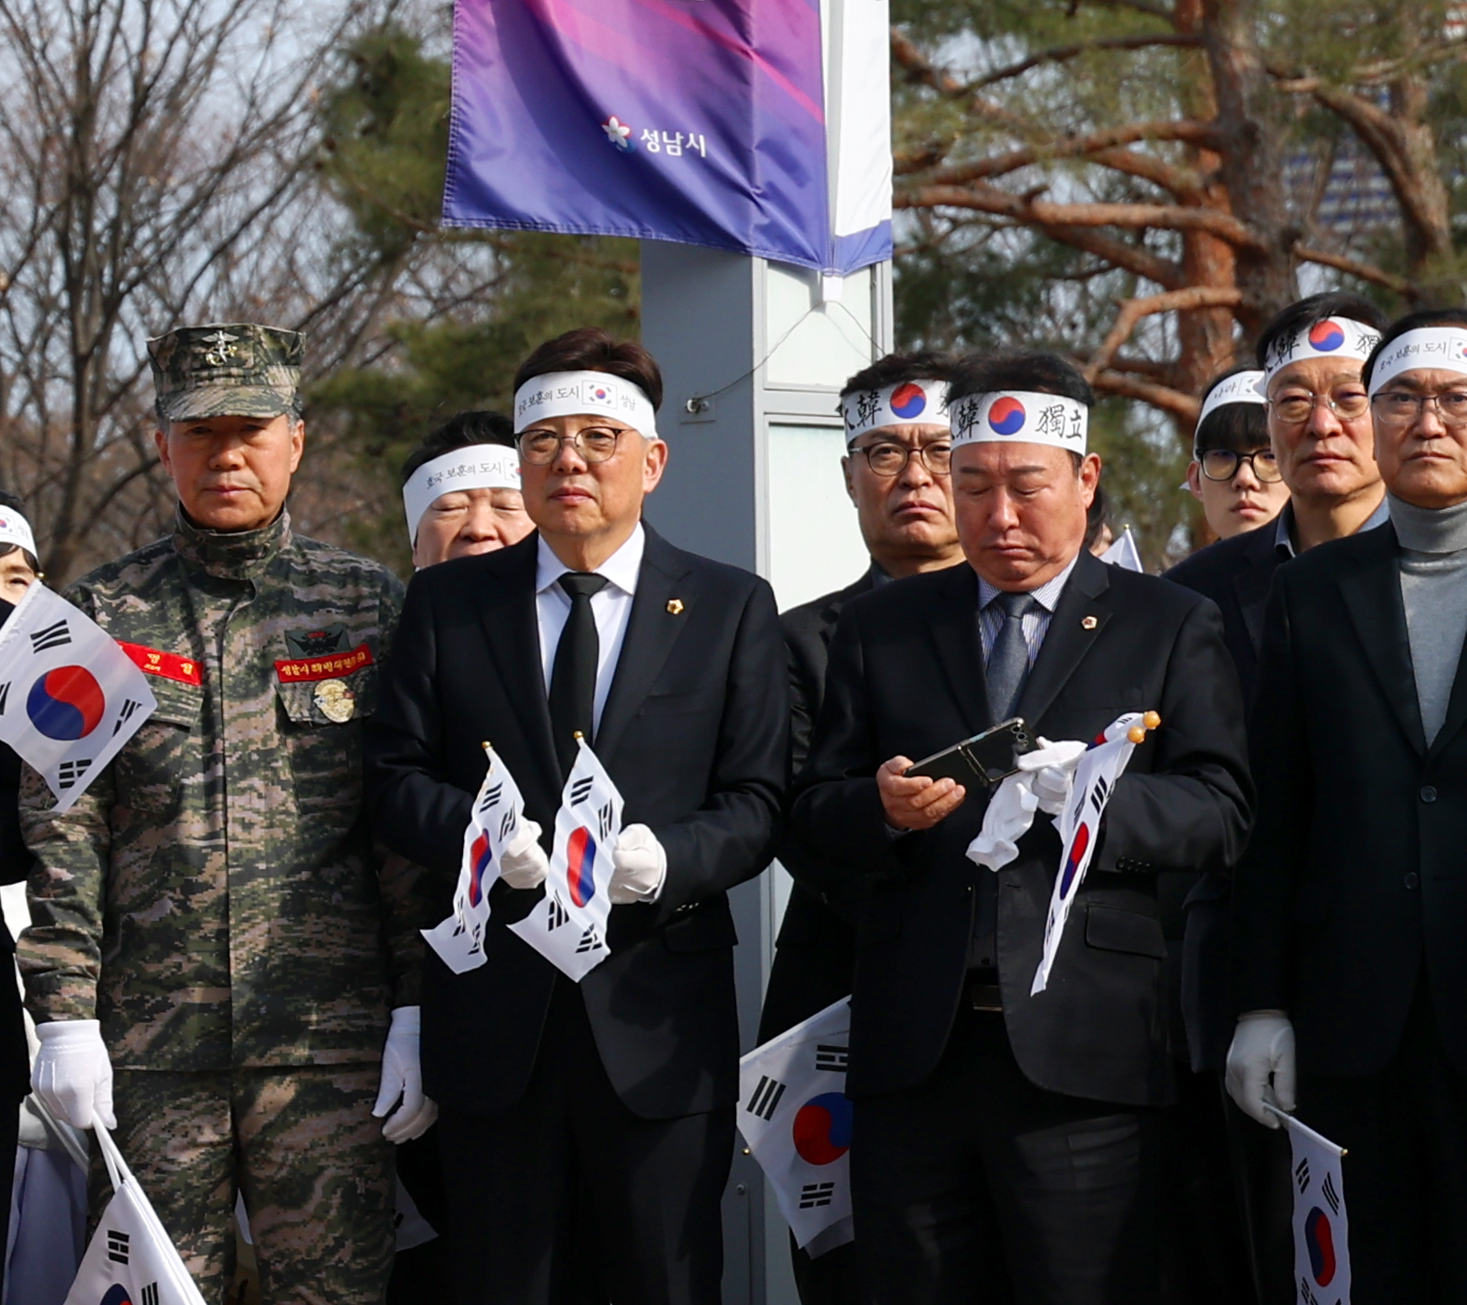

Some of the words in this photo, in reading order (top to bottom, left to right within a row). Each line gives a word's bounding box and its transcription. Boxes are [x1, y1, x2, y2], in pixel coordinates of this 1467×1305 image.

[640, 126, 708, 159] 성남시
[1423, 342, 1447, 354] 도시
[528, 390, 553, 408] 보훈의
[556, 385, 580, 400] 도시
[952, 398, 981, 440] 韓
[1035, 403, 1083, 440] 獨立
[426, 472, 443, 490] 호국
[446, 464, 477, 479] 보훈의
[479, 461, 502, 475] 도시
